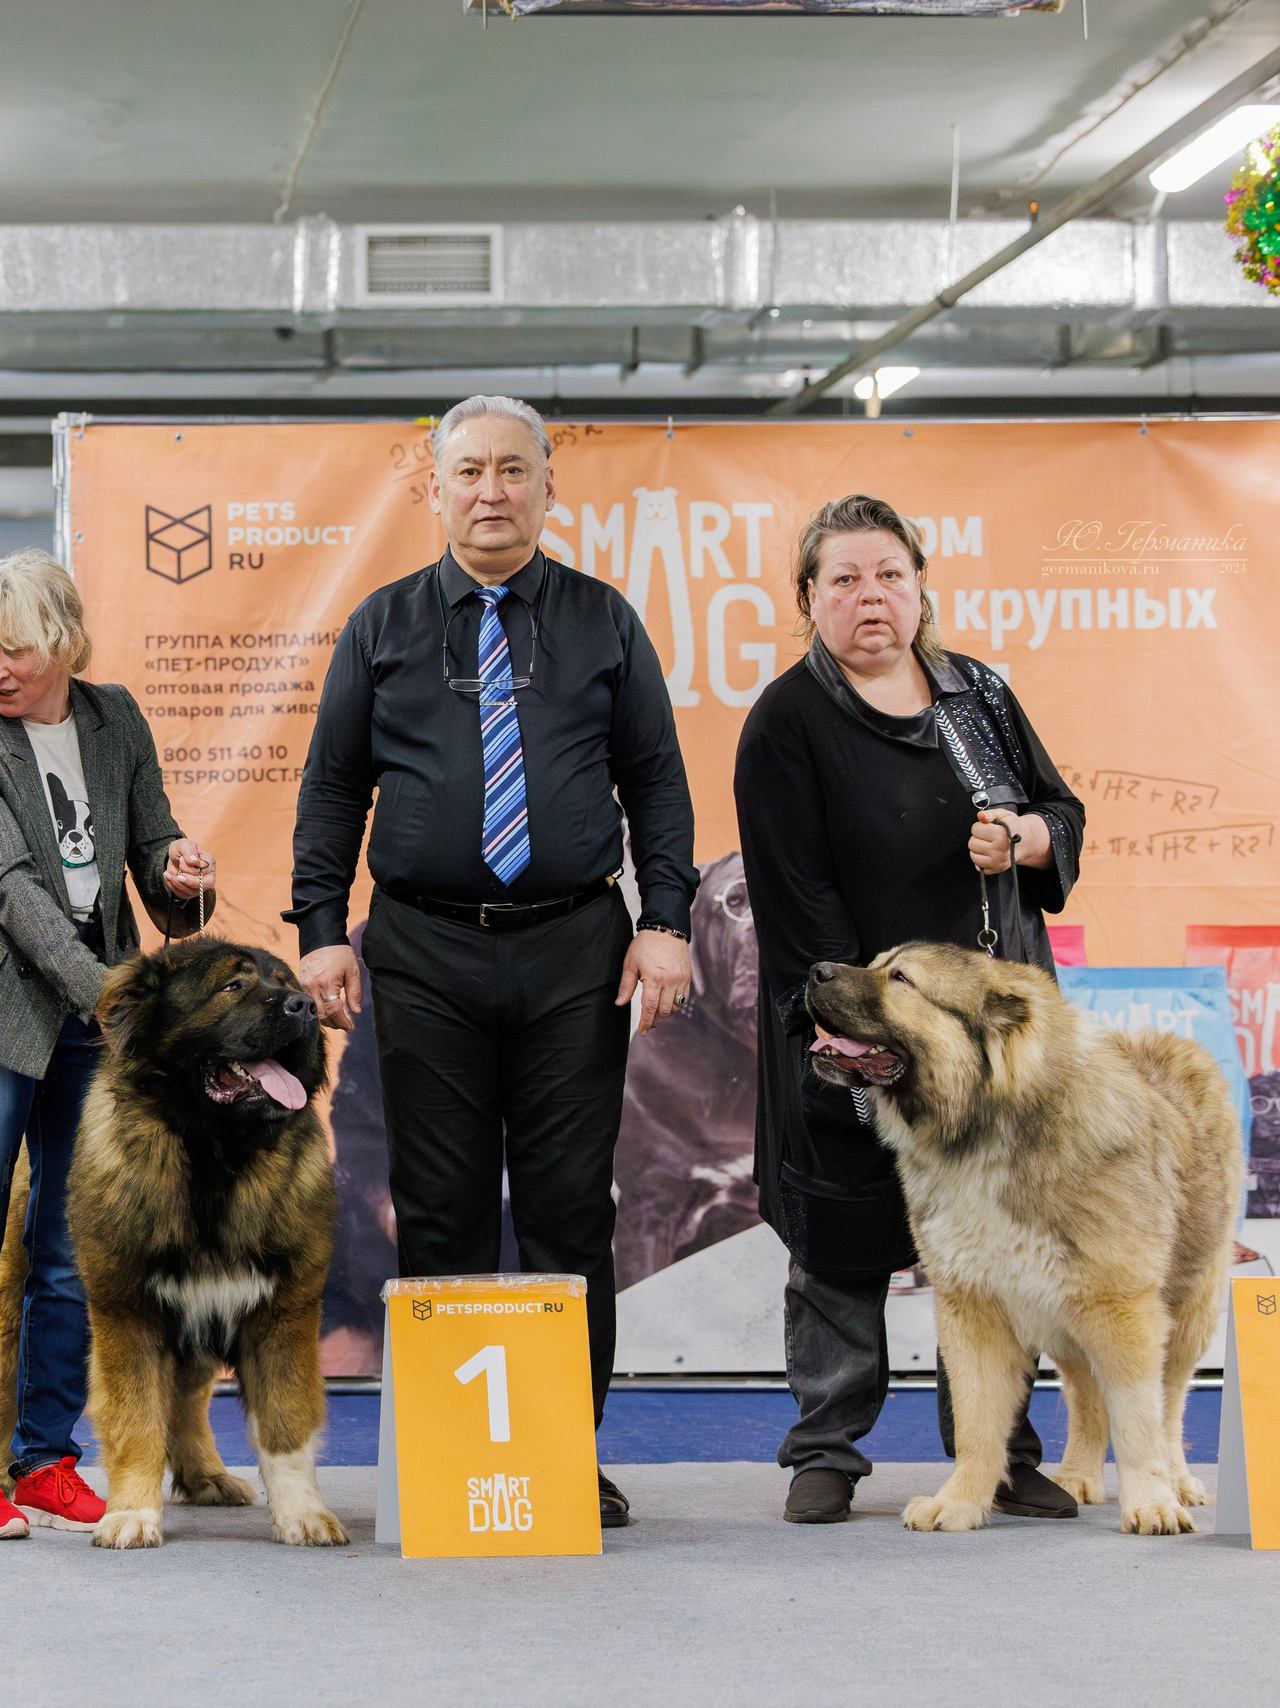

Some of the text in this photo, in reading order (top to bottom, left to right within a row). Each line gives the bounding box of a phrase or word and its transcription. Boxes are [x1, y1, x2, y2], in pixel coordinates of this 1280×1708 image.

[227, 501, 297, 522] PETS
[227, 525, 356, 547] PRODUCT
[229, 552, 264, 570] RU
[954, 587, 1218, 650] крупных
[145, 634, 224, 650] ГРУППА
[145, 655, 310, 673] «ПЕТ-ПРОДУКТ»
[145, 680, 315, 697] оптовая продажа
[146, 706, 224, 719] товаров
[230, 704, 265, 719] для
[163, 745, 288, 762] 800 511 40 10
[453, 1344, 511, 1443] 1
[467, 1473, 531, 1498] SMART
